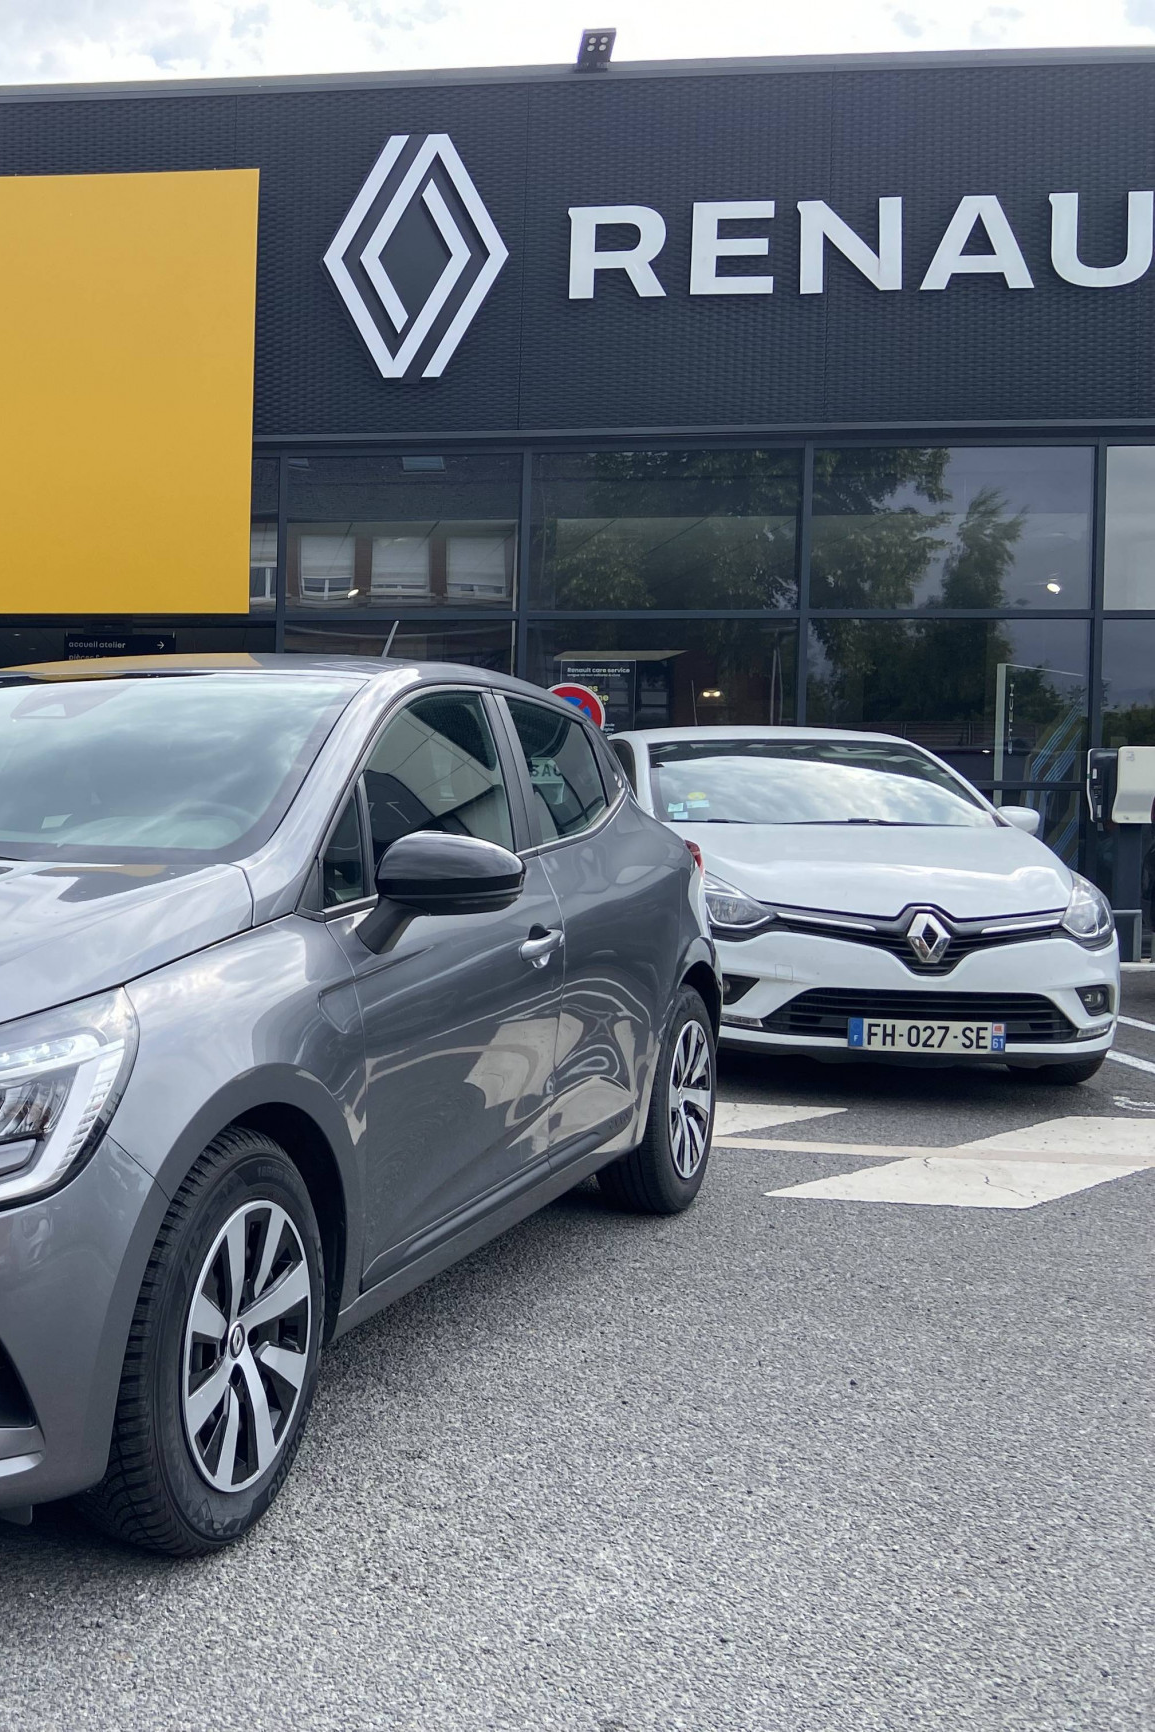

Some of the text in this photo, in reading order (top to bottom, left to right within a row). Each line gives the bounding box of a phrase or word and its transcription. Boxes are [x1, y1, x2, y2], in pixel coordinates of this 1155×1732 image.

[568, 190, 1154, 300] RENAU
[68, 641, 126, 649] accueil atelier
[867, 1023, 989, 1050] FH-027-SE
[992, 1038, 1004, 1049] 61
